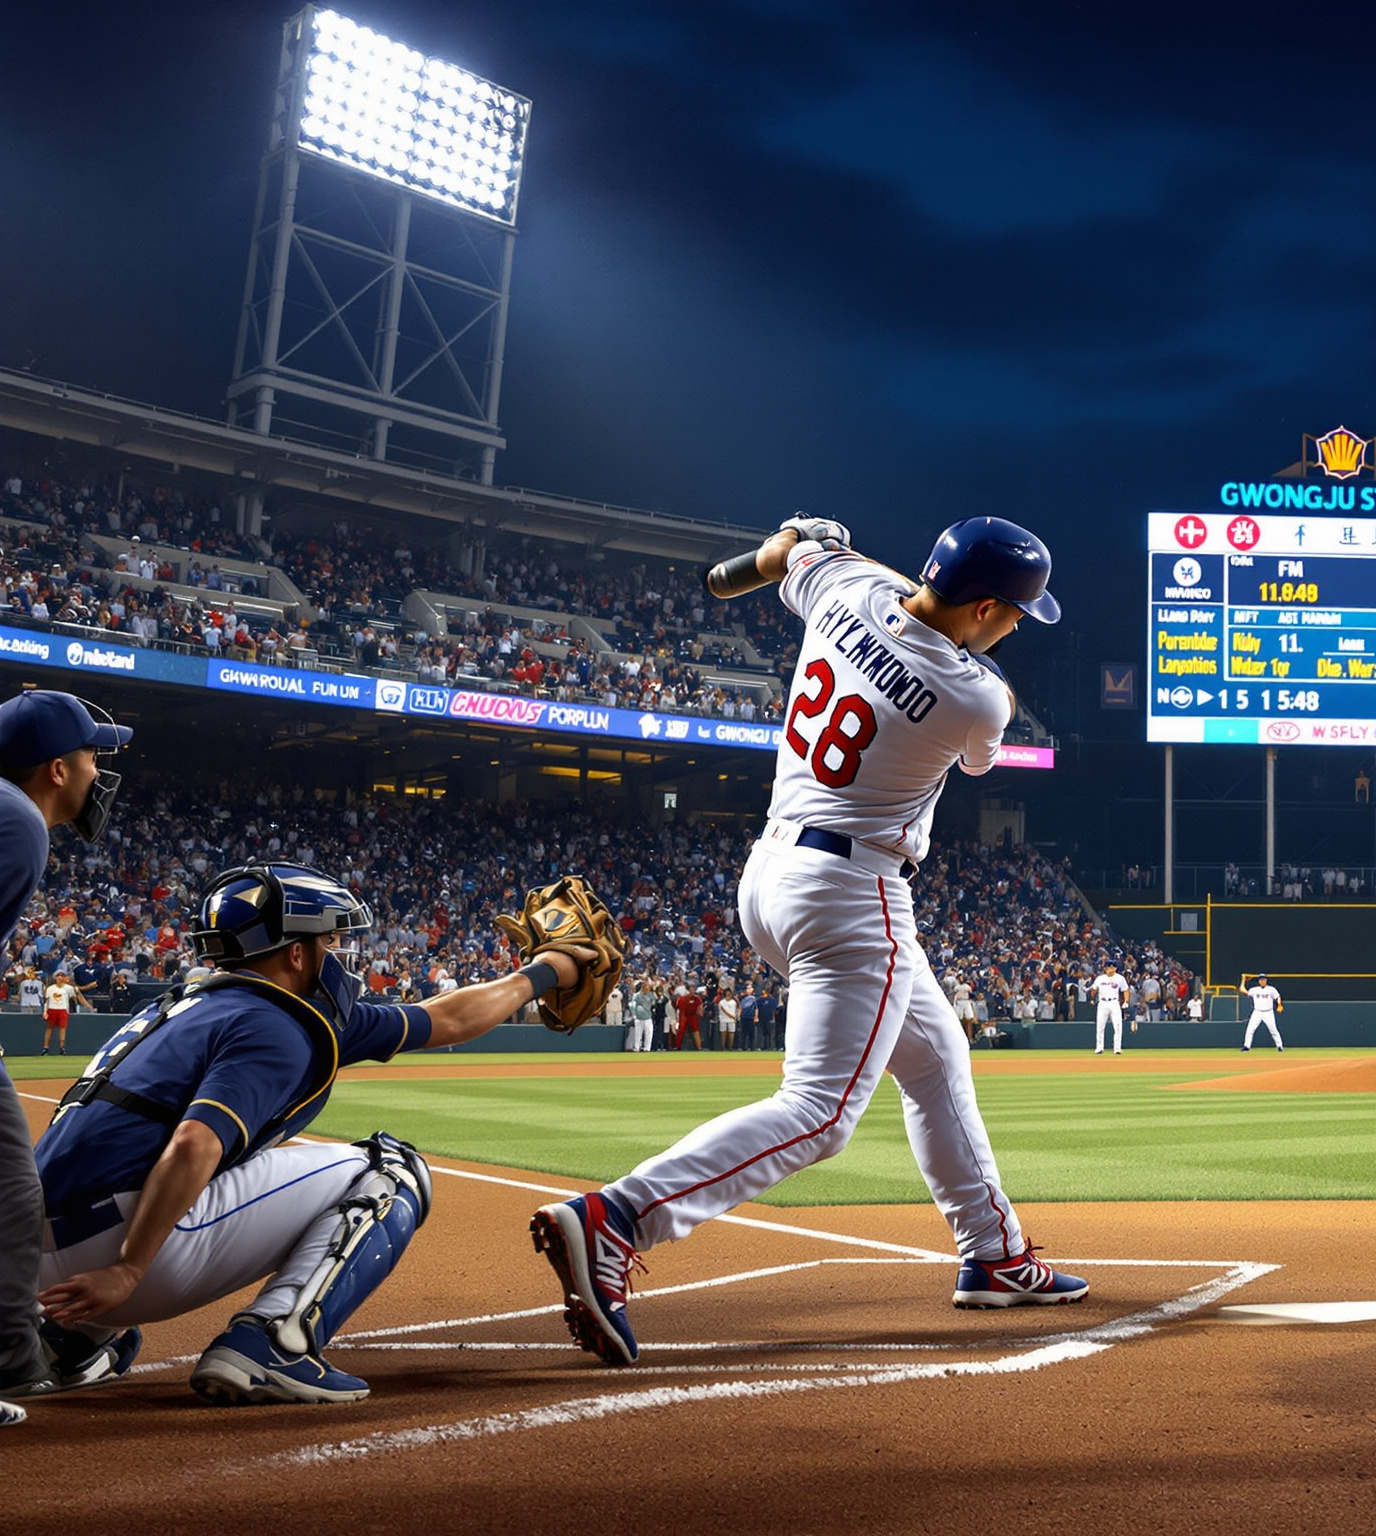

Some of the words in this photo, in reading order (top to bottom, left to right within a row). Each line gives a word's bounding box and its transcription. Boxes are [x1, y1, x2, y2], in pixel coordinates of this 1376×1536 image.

[1220, 482, 1355, 510] GWONGJU
[1278, 560, 1303, 578] FM
[786, 657, 878, 789] 28
